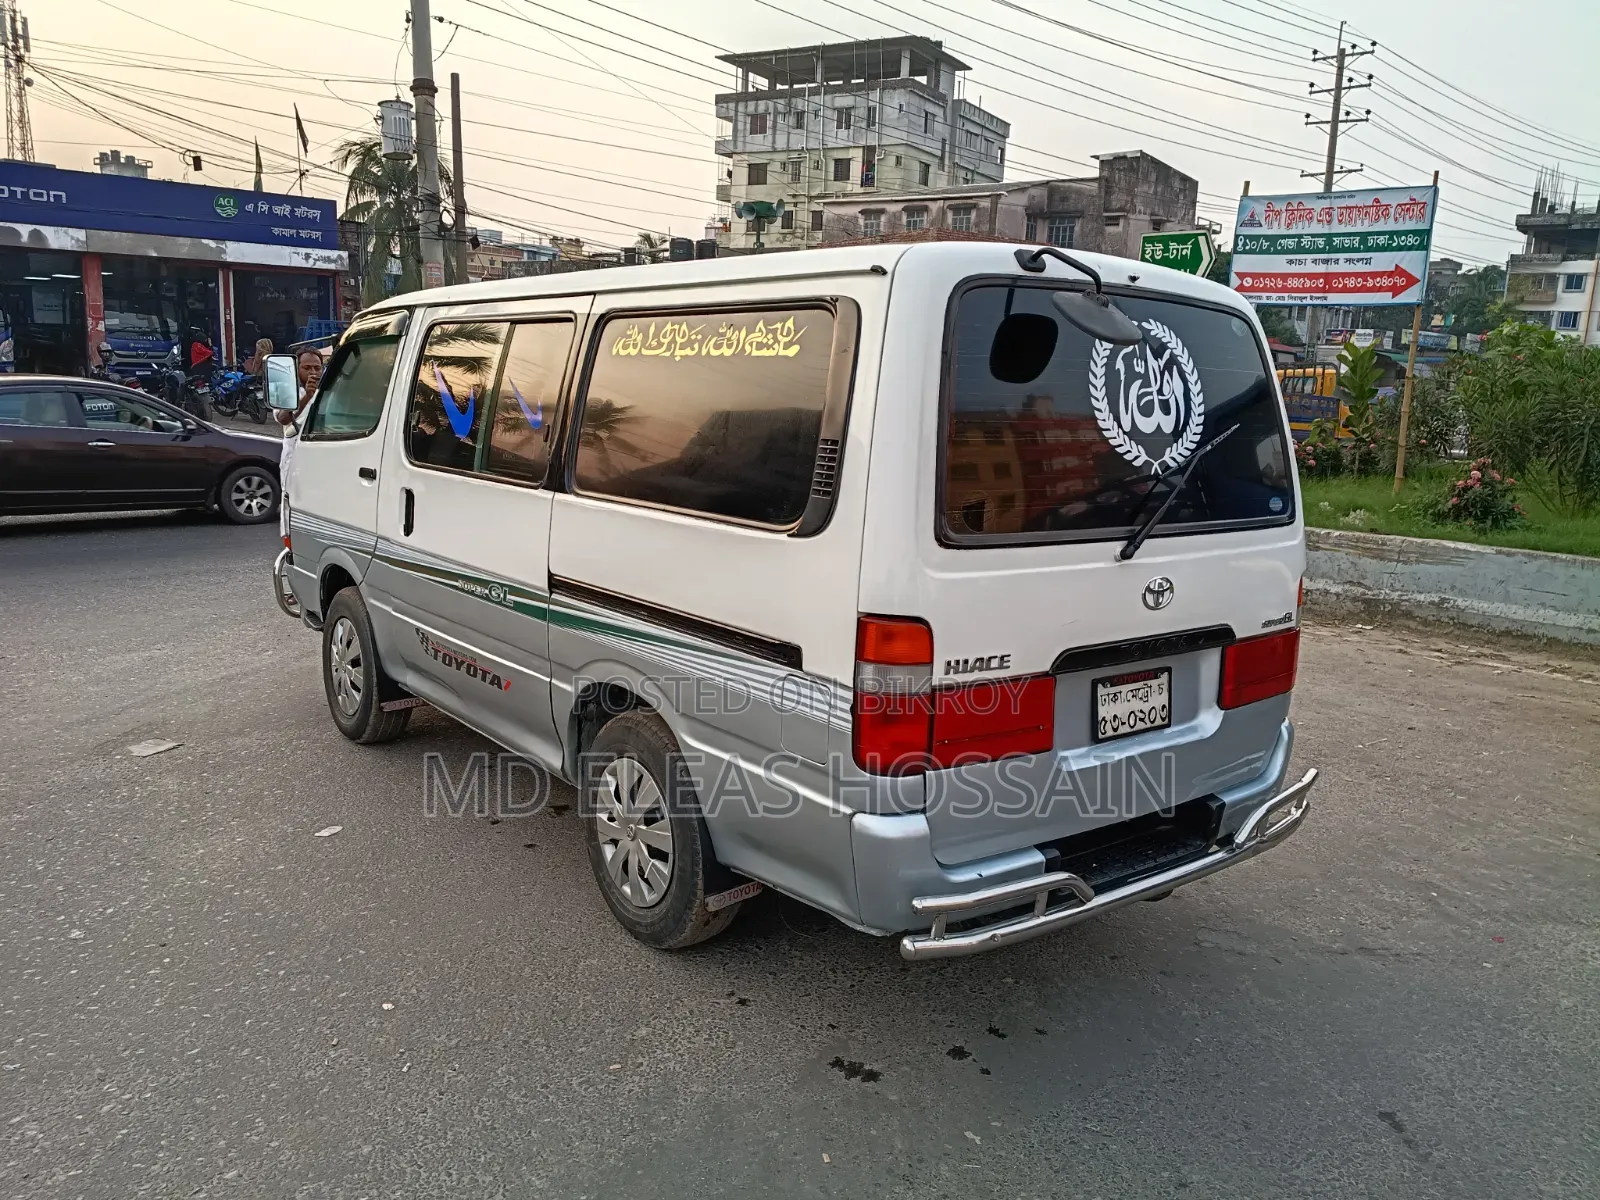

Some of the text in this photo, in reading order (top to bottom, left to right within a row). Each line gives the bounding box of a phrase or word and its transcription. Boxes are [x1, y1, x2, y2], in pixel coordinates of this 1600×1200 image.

[218, 197, 234, 206] ACI
[245, 203, 254, 213] এ
[258, 201, 269, 215] সি
[271, 204, 291, 218] আই
[1264, 202, 1282, 229] দীপ
[1284, 201, 1315, 230] ক্লিনিক
[1393, 195, 1428, 224] সেন্টার
[270, 227, 297, 237] কামাল
[1144, 238, 1195, 262] ইউ-টার্ন
[1311, 258, 1340, 266] বাজার
[488, 583, 514, 607] GL
[431, 647, 504, 690] TOYOTA
[944, 654, 1012, 676] HIACE
[1100, 690, 1123, 706] ঢাকা
[1099, 703, 1168, 735] ৫৩-০২০৩
[727, 881, 764, 901] TOYOTA
